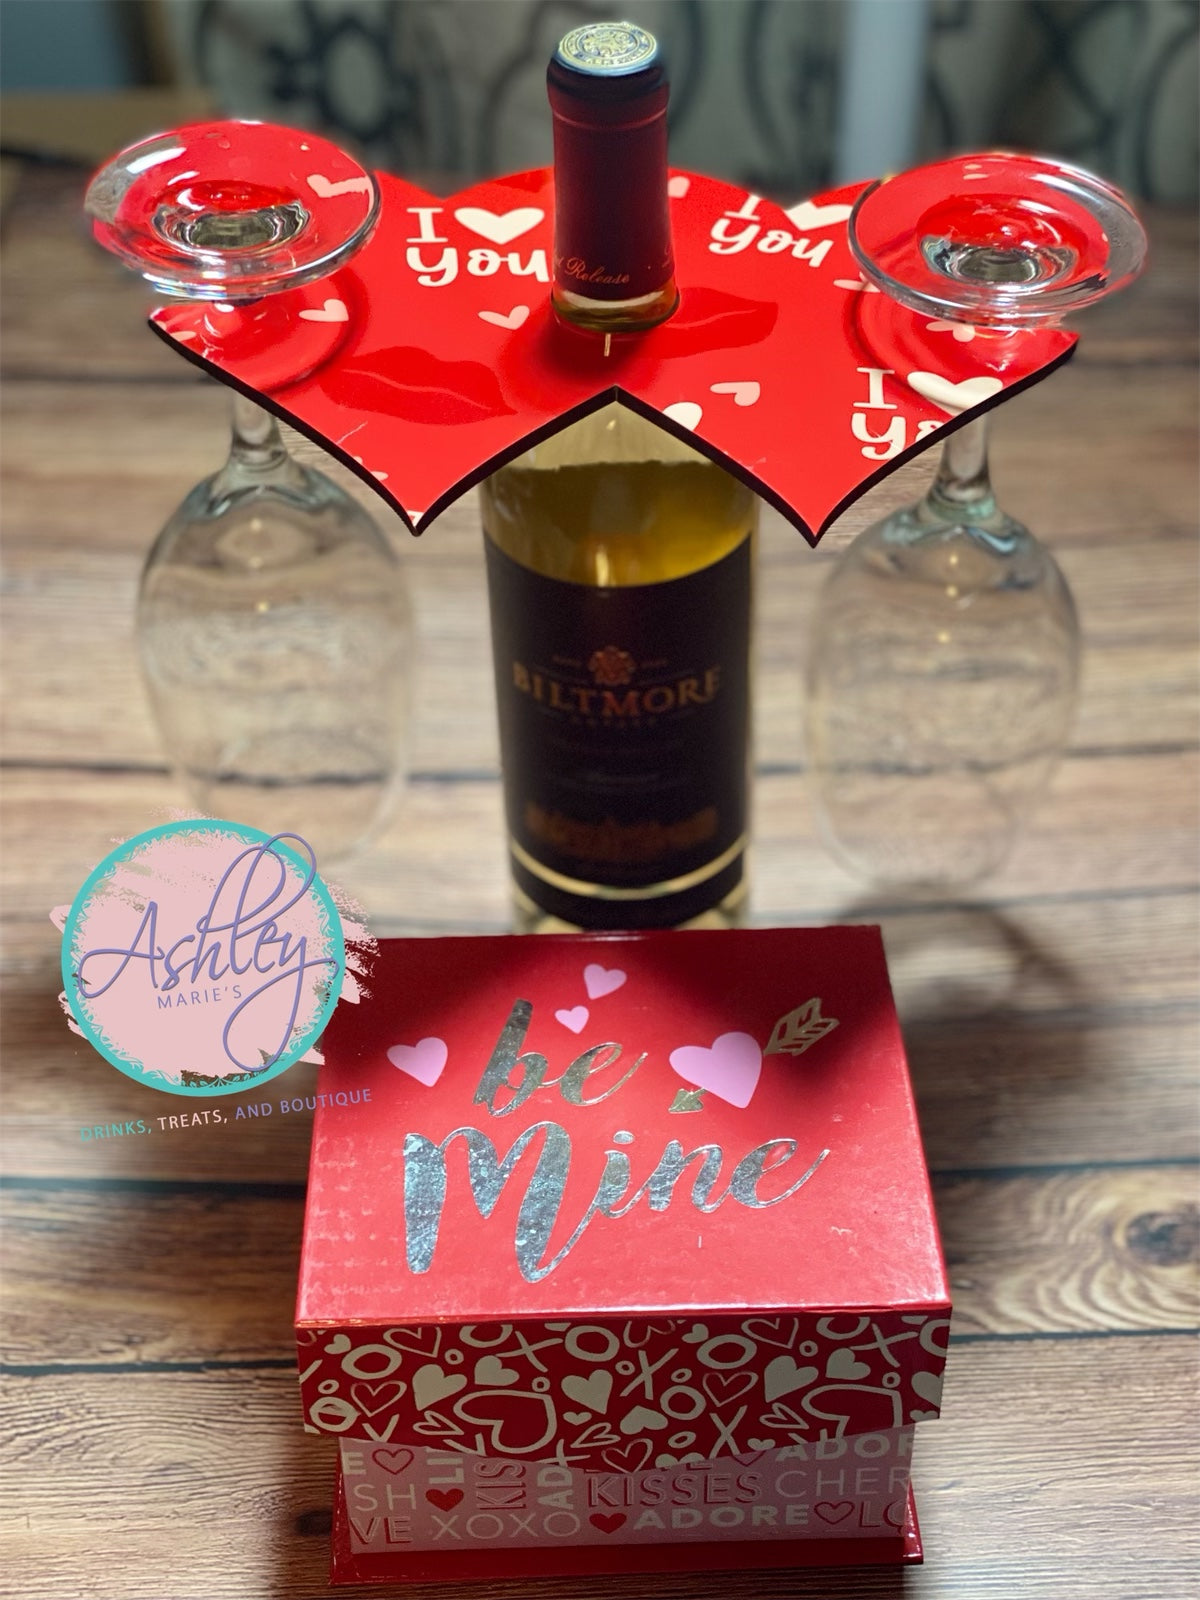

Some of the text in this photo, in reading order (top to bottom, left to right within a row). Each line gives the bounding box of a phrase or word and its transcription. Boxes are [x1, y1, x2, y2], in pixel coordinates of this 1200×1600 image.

[406, 207, 450, 243] I
[565, 257, 630, 284] Release
[853, 367, 898, 409] I
[513, 661, 721, 717] BILTMORE
[473, 998, 648, 1117] be
[403, 1121, 831, 1283] Mine
[588, 1472, 764, 1507] KISSES
[430, 1511, 581, 1541] XOXO
[633, 1504, 810, 1531] ADORE
